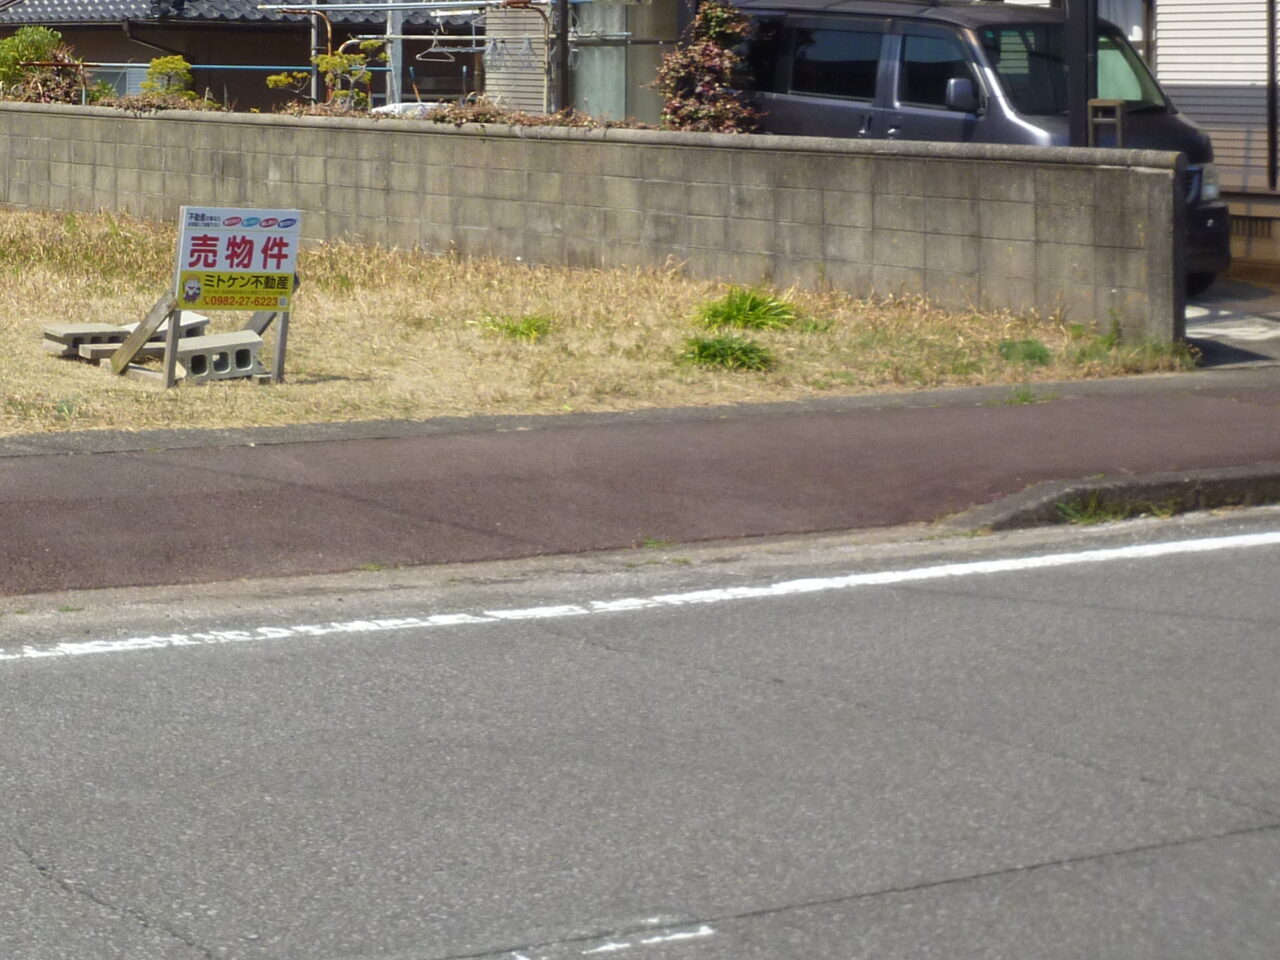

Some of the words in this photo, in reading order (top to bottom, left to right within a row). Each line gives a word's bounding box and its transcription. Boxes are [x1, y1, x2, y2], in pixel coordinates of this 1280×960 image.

[188, 234, 290, 270] 売物件
[203, 274, 289, 290] ミトケン不動産
[210, 295, 279, 307] 0982-27-6223
